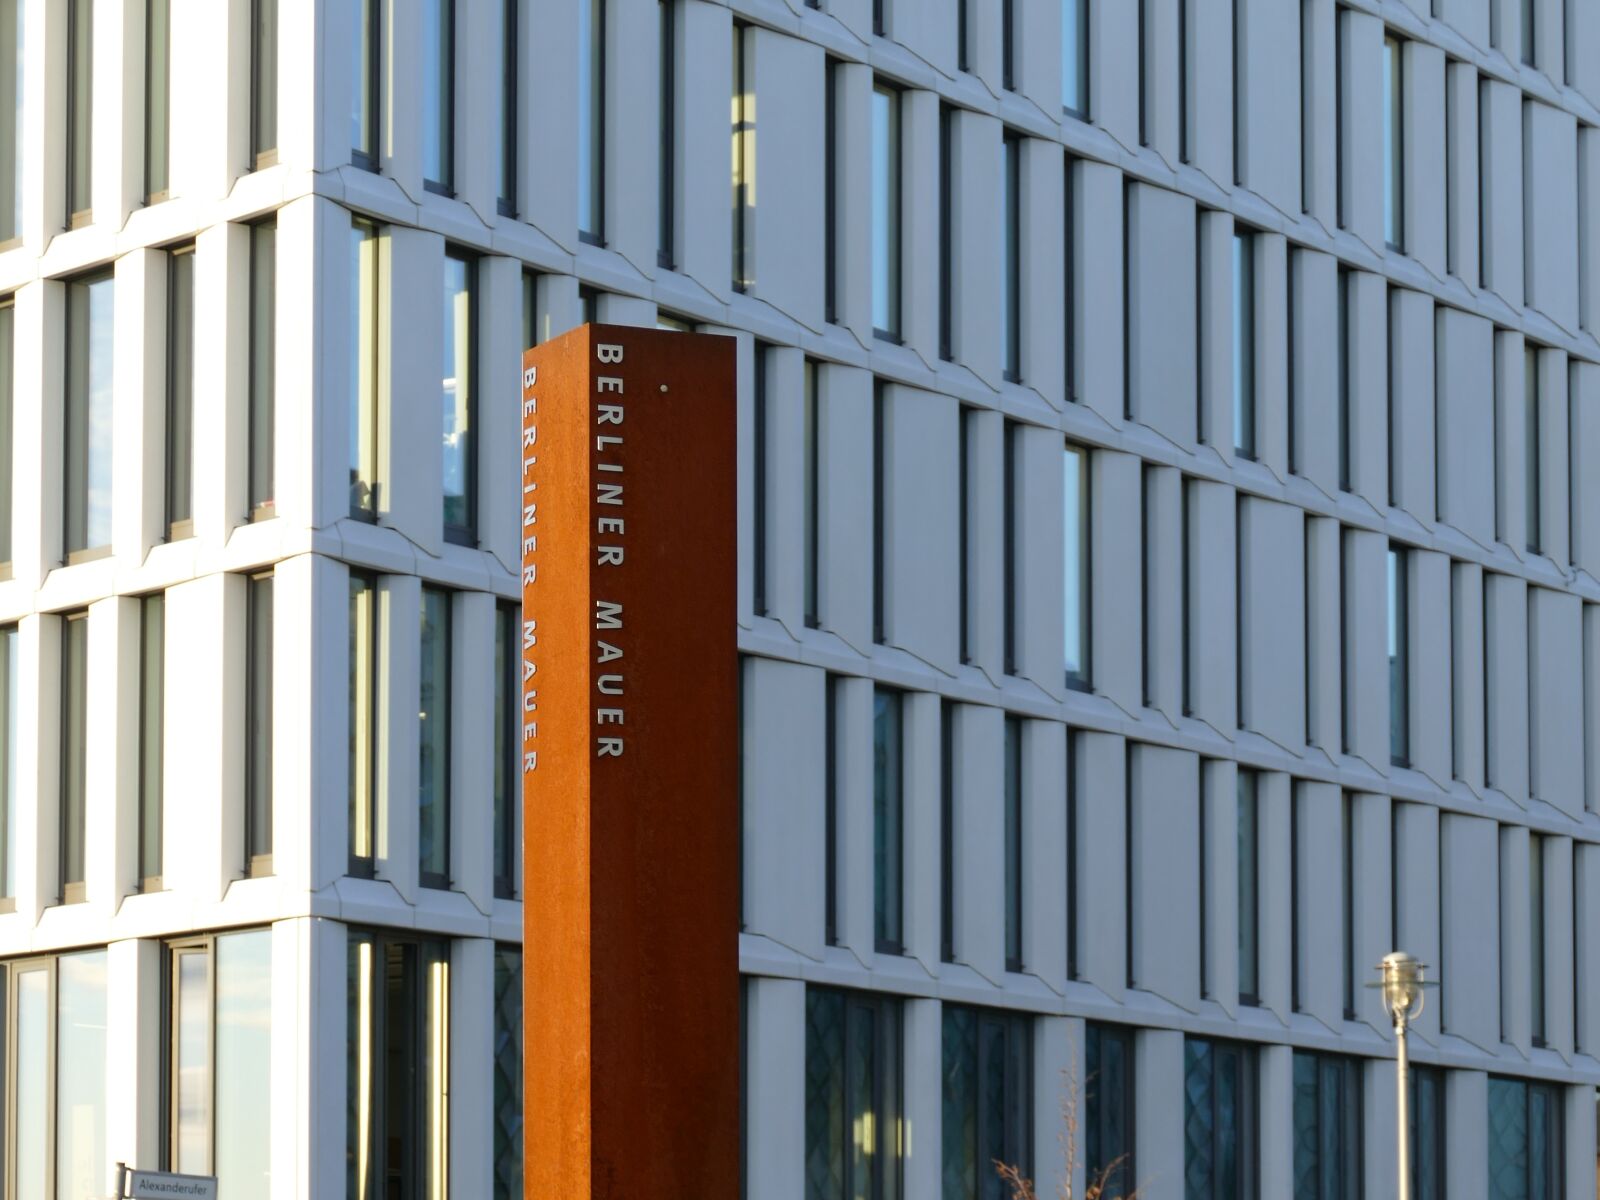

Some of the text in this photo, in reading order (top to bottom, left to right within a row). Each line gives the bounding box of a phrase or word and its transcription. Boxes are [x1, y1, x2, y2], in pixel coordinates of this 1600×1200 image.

[523, 366, 537, 772] BERLINER MAUER
[596, 343, 624, 758] BERLINER MAUER
[139, 1179, 207, 1195] Alexanderufer
